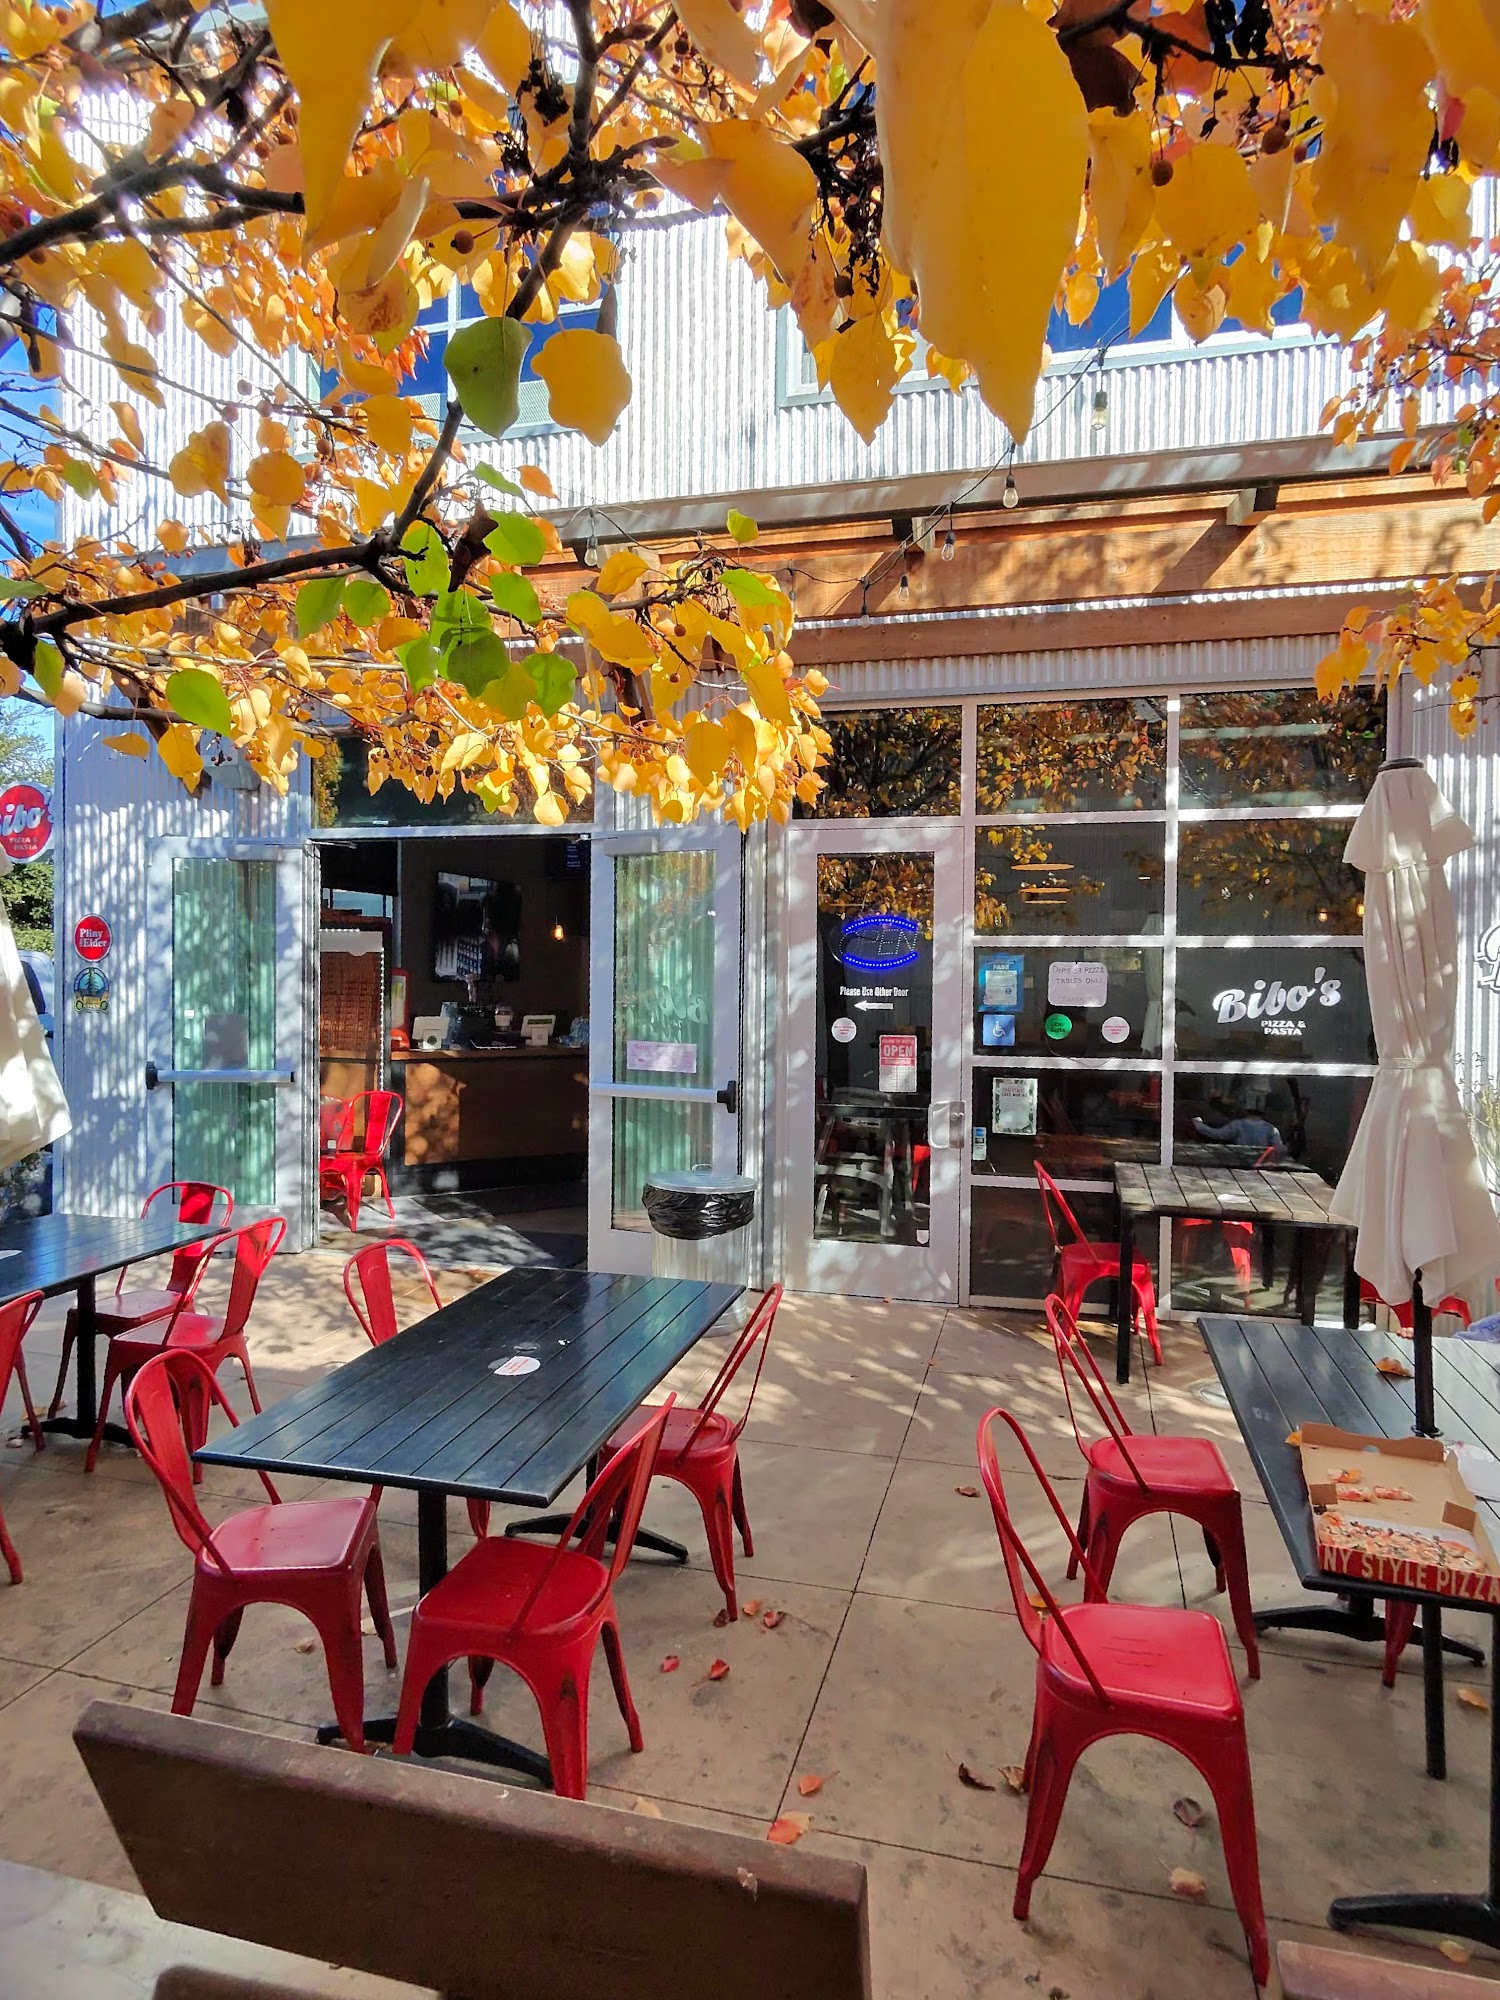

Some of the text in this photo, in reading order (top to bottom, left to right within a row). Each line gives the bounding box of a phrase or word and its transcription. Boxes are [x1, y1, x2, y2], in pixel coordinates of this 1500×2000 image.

[0, 791, 54, 837] ibo'
[79, 928, 103, 939] Pliny
[83, 938, 107, 947] Elder
[838, 929, 918, 955] OPEN
[1084, 966, 1104, 974] PIZZA
[839, 986, 909, 997] Please Use Other Door
[1212, 966, 1341, 1024] Bibo's
[1260, 1020, 1306, 1028] PIZZA &
[1264, 1027, 1303, 1036] PASTA
[883, 1045, 913, 1057] OPEN
[1323, 1546, 1500, 1603] NY STYLE PIZZA
